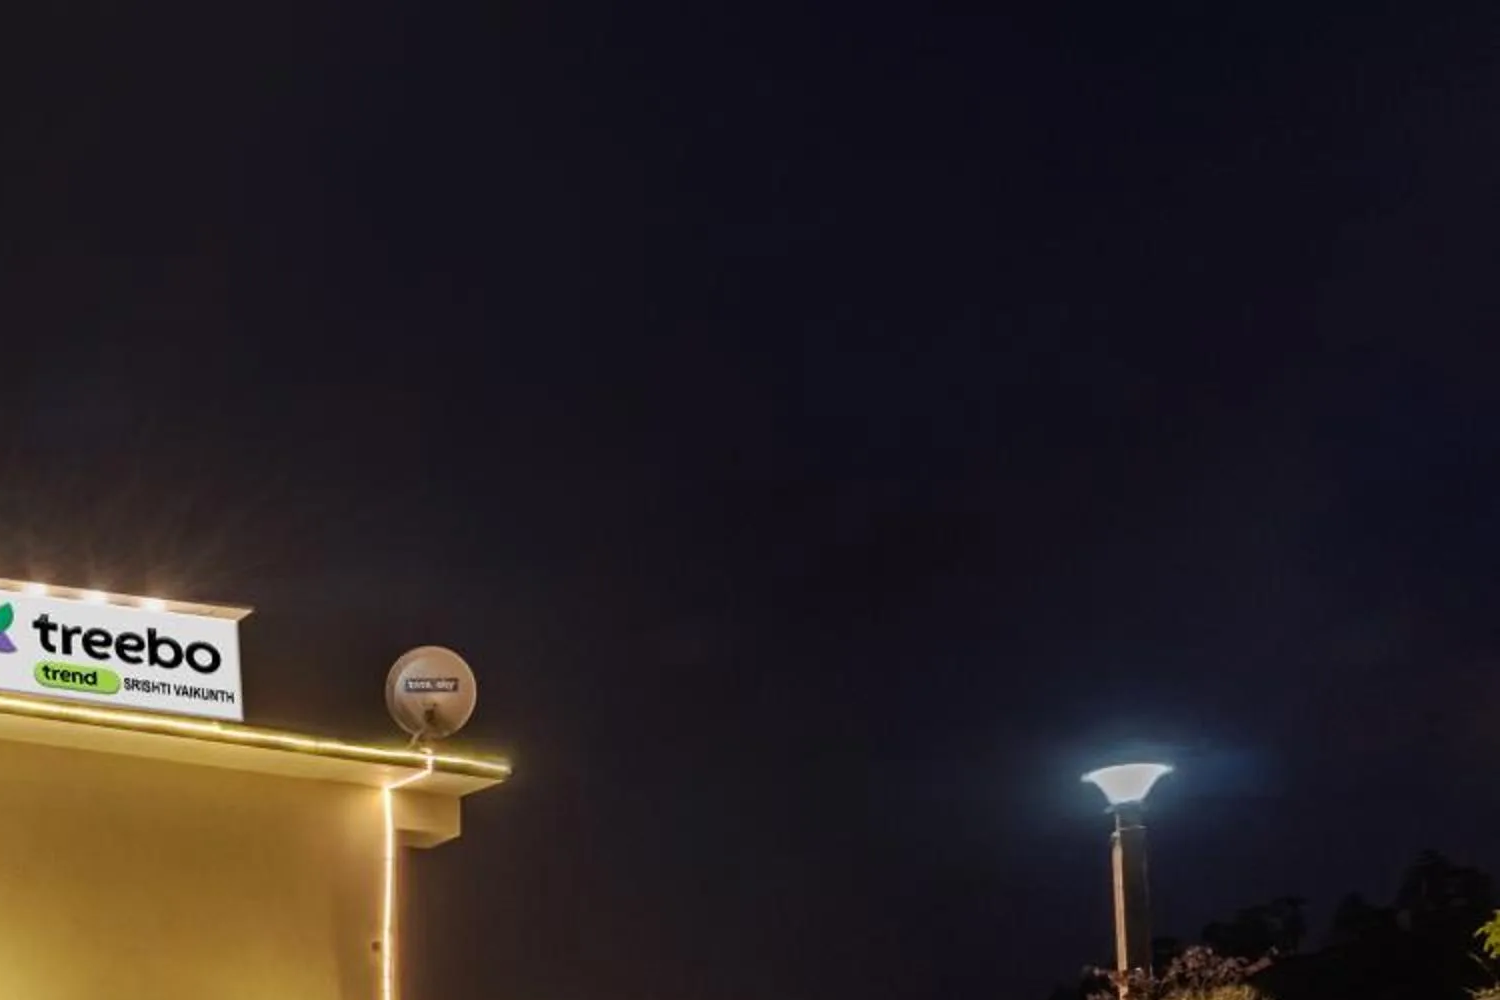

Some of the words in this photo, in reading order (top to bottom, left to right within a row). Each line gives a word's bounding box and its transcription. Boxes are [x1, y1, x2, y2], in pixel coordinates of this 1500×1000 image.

[32, 613, 221, 674] treebo
[42, 665, 98, 686] trend
[123, 677, 171, 695] SRISHTI
[174, 684, 235, 704] VAIKUNTH
